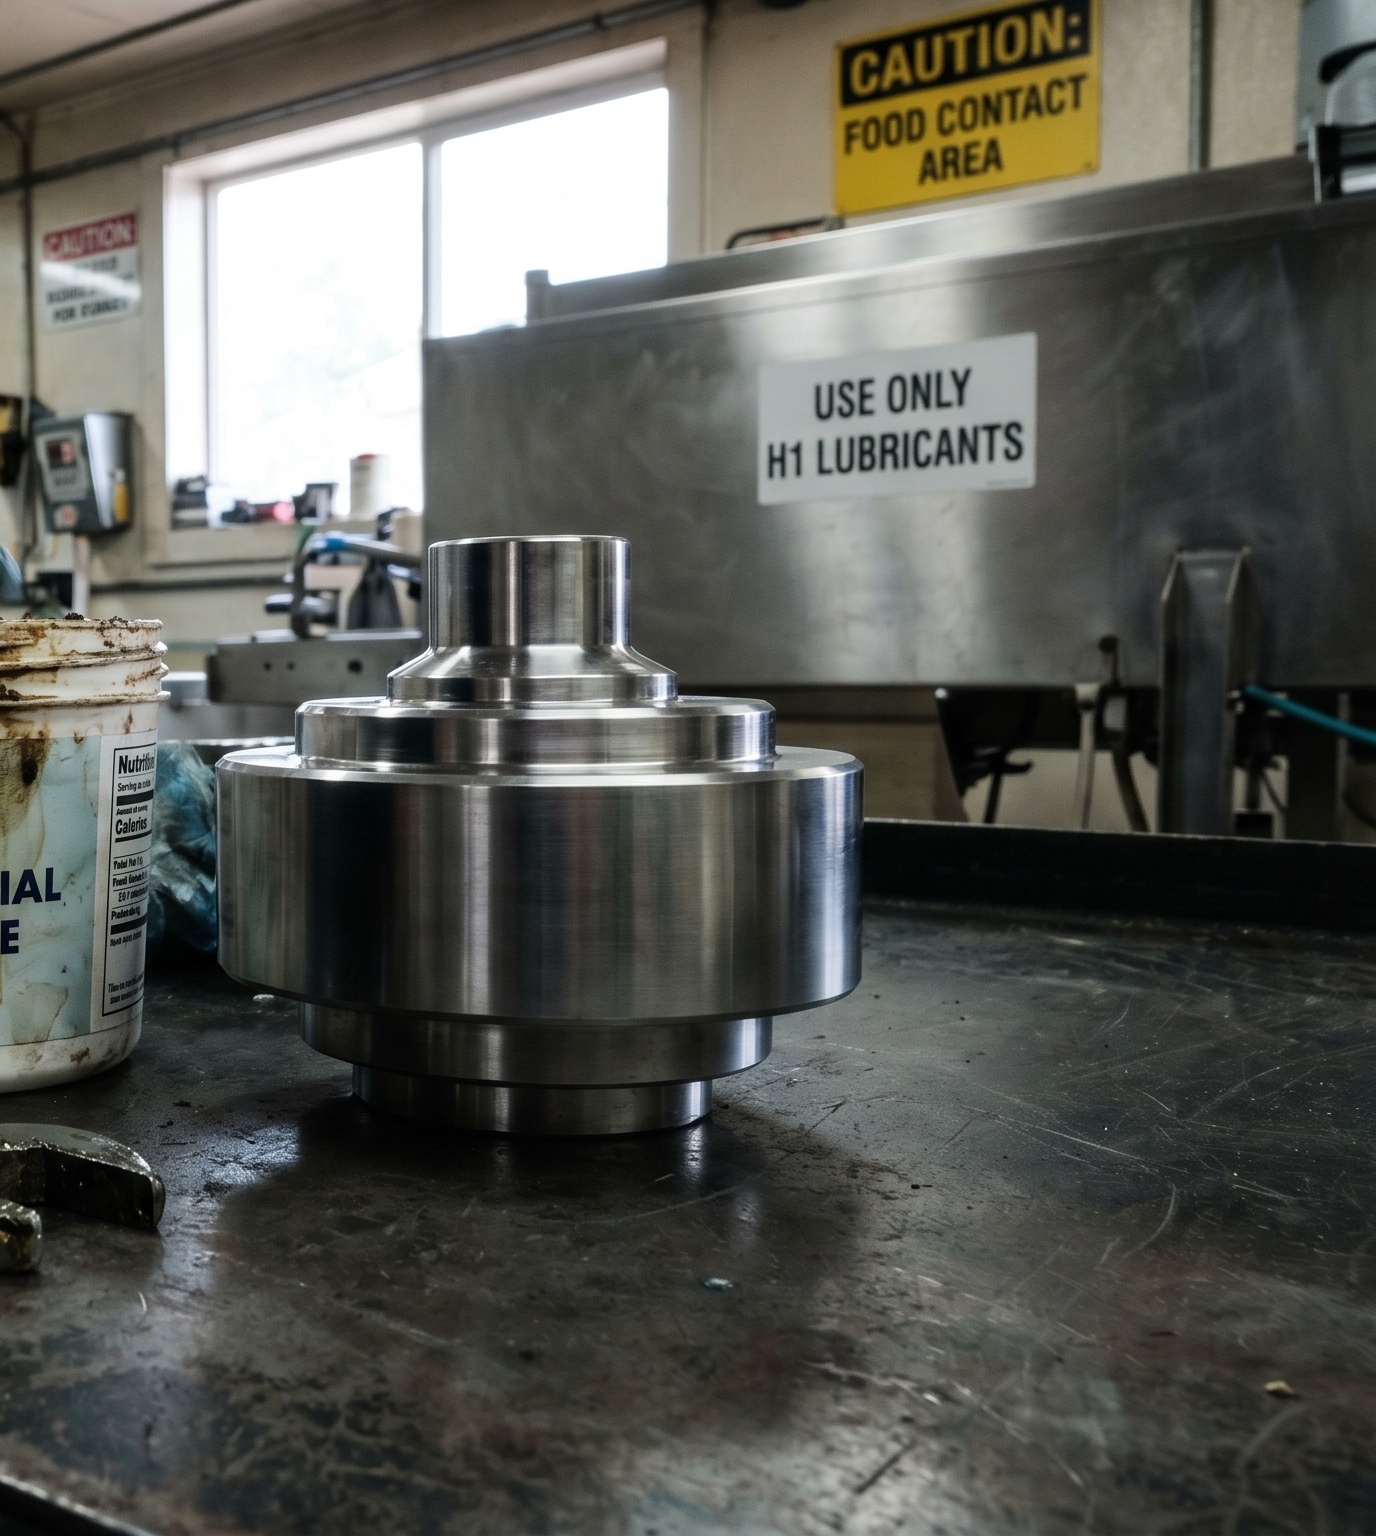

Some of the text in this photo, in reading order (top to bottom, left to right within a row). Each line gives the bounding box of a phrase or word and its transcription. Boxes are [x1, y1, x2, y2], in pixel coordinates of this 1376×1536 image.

[849, 5, 1081, 97] CAUTION:
[844, 73, 1088, 156] FOOD CONTACT
[918, 137, 1003, 185] AREA
[815, 366, 971, 421] USE ONLY
[767, 421, 1024, 479] H1 LUBRICANTS
